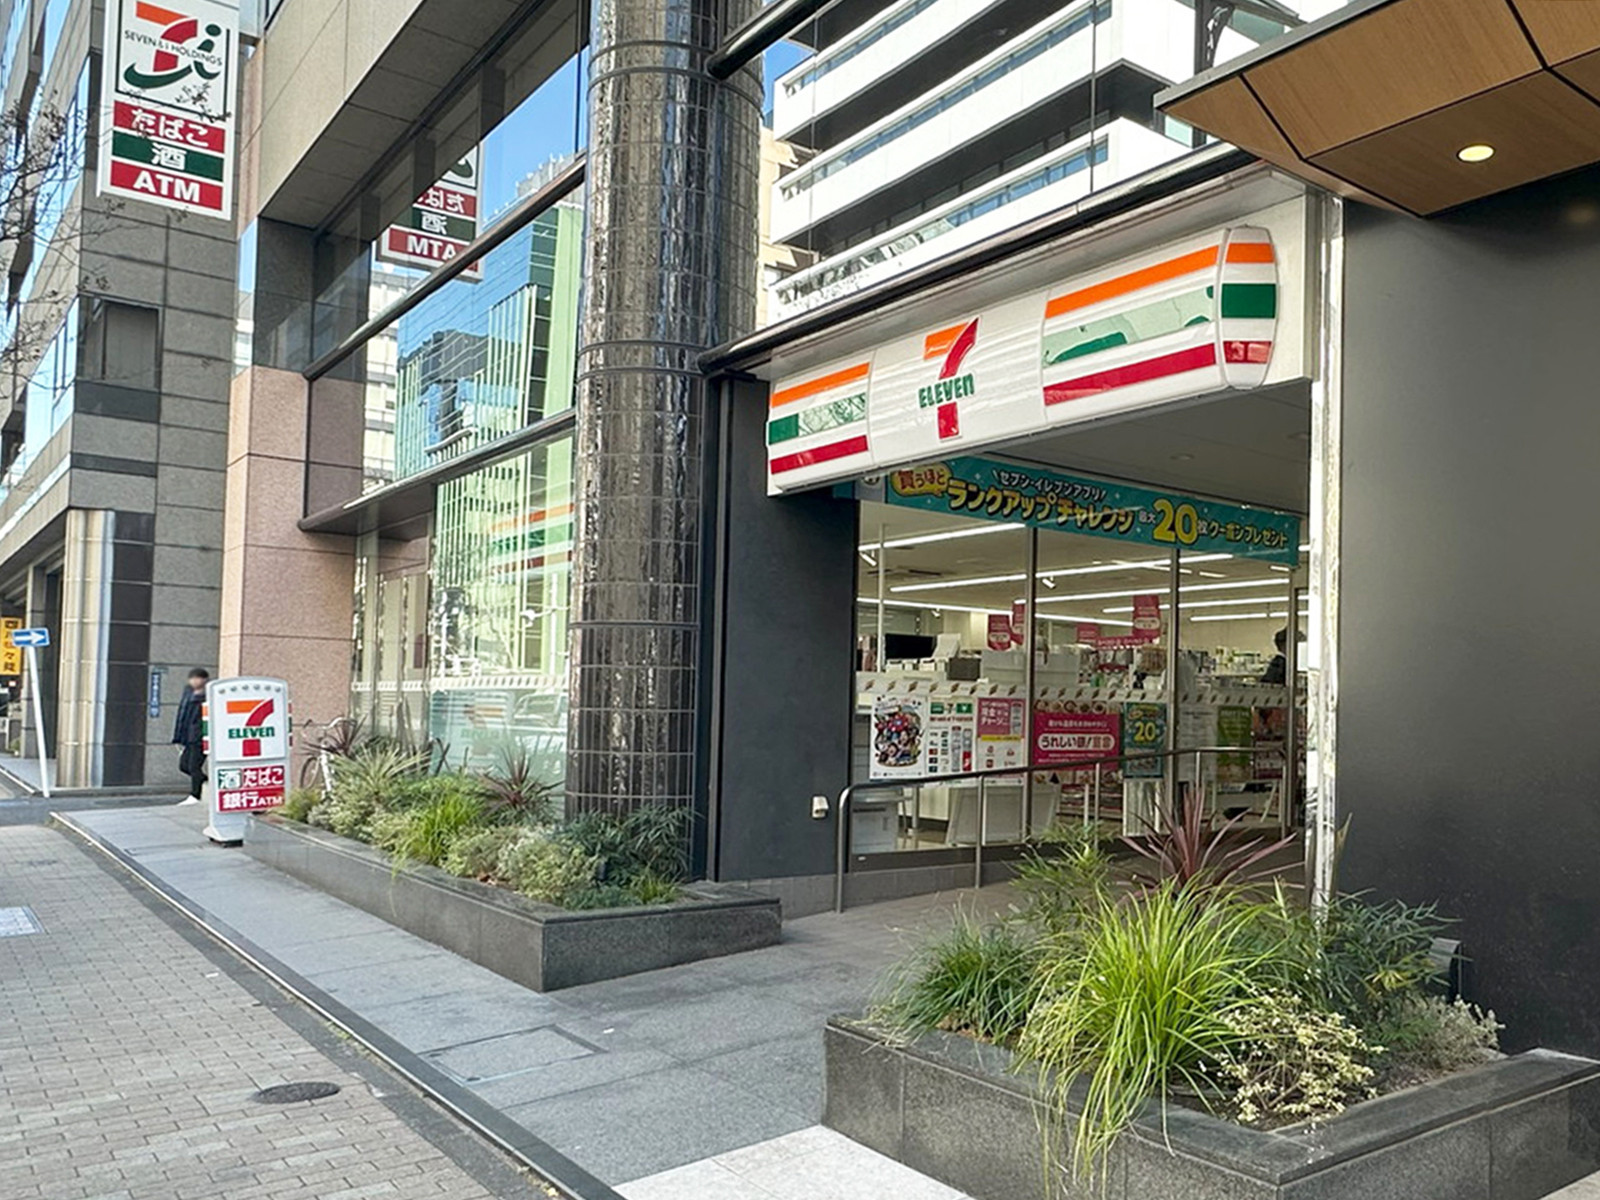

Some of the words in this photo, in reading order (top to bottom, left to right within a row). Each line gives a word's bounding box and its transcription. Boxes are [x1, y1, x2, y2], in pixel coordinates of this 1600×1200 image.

[124, 30, 156, 46] SEVEN
[171, 44, 223, 67] HOLDINGS
[131, 108, 209, 147] たばこ
[152, 142, 187, 171] 酒
[133, 169, 200, 203] ATM
[948, 478, 1135, 533] ランクアップチャレンジ
[1134, 721, 1156, 742] 20
[219, 770, 242, 790] 酒
[243, 767, 284, 786] たばこ
